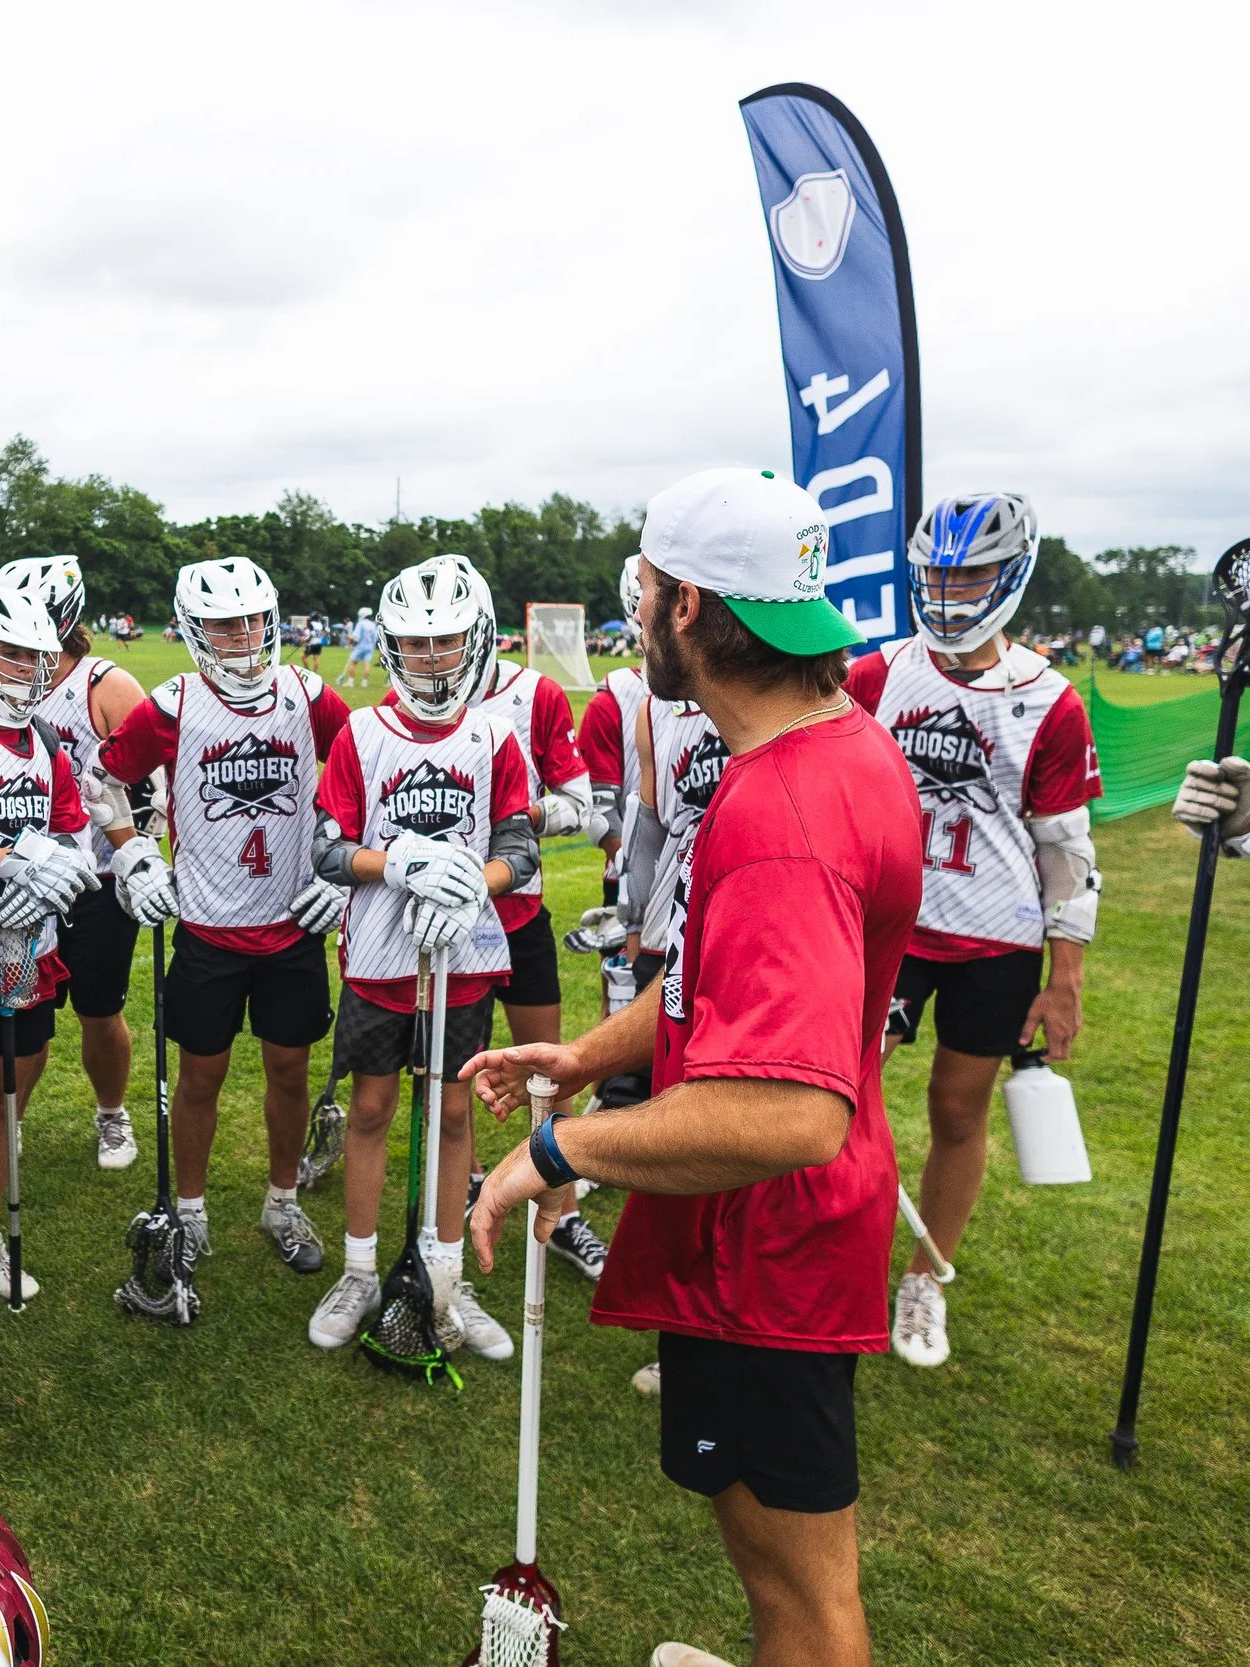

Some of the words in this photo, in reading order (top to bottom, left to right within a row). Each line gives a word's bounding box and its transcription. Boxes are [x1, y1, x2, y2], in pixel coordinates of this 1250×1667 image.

[796, 524, 820, 540] GOOD
[205, 757, 295, 786] HOOSIER
[237, 780, 266, 791] ELITE
[382, 788, 473, 822] HOOSIER
[411, 813, 441, 824] ELITE
[238, 826, 272, 878] 4
